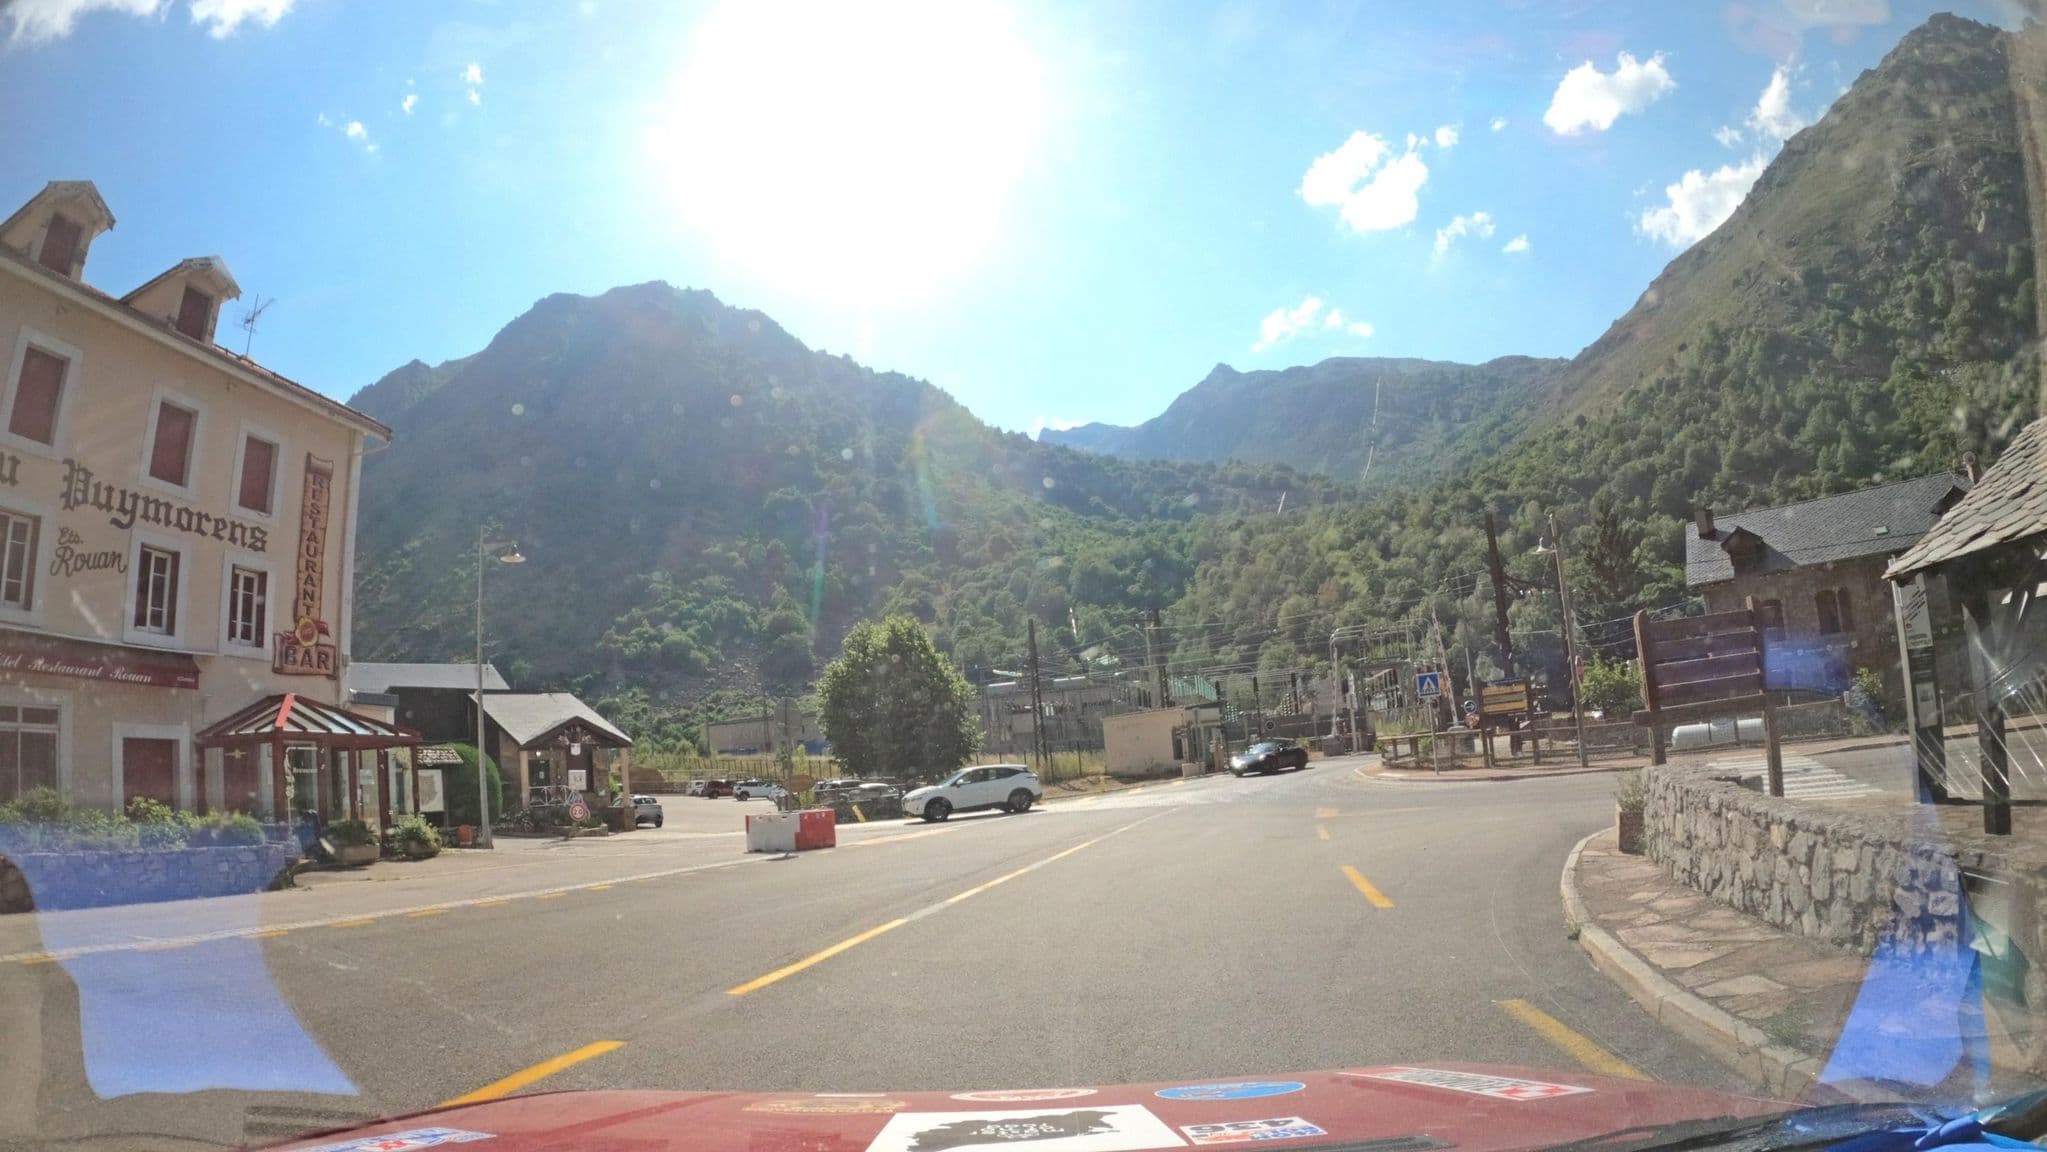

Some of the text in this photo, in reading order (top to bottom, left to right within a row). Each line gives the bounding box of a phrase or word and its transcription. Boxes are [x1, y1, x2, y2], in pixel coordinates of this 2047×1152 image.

[0, 452, 267, 552] u Puymorens
[304, 473, 326, 616] RESTAURANT
[50, 546, 126, 578] Rouan
[28, 657, 104, 678] Restaurant
[110, 667, 152, 683] Rouan
[284, 646, 331, 671] BAR
